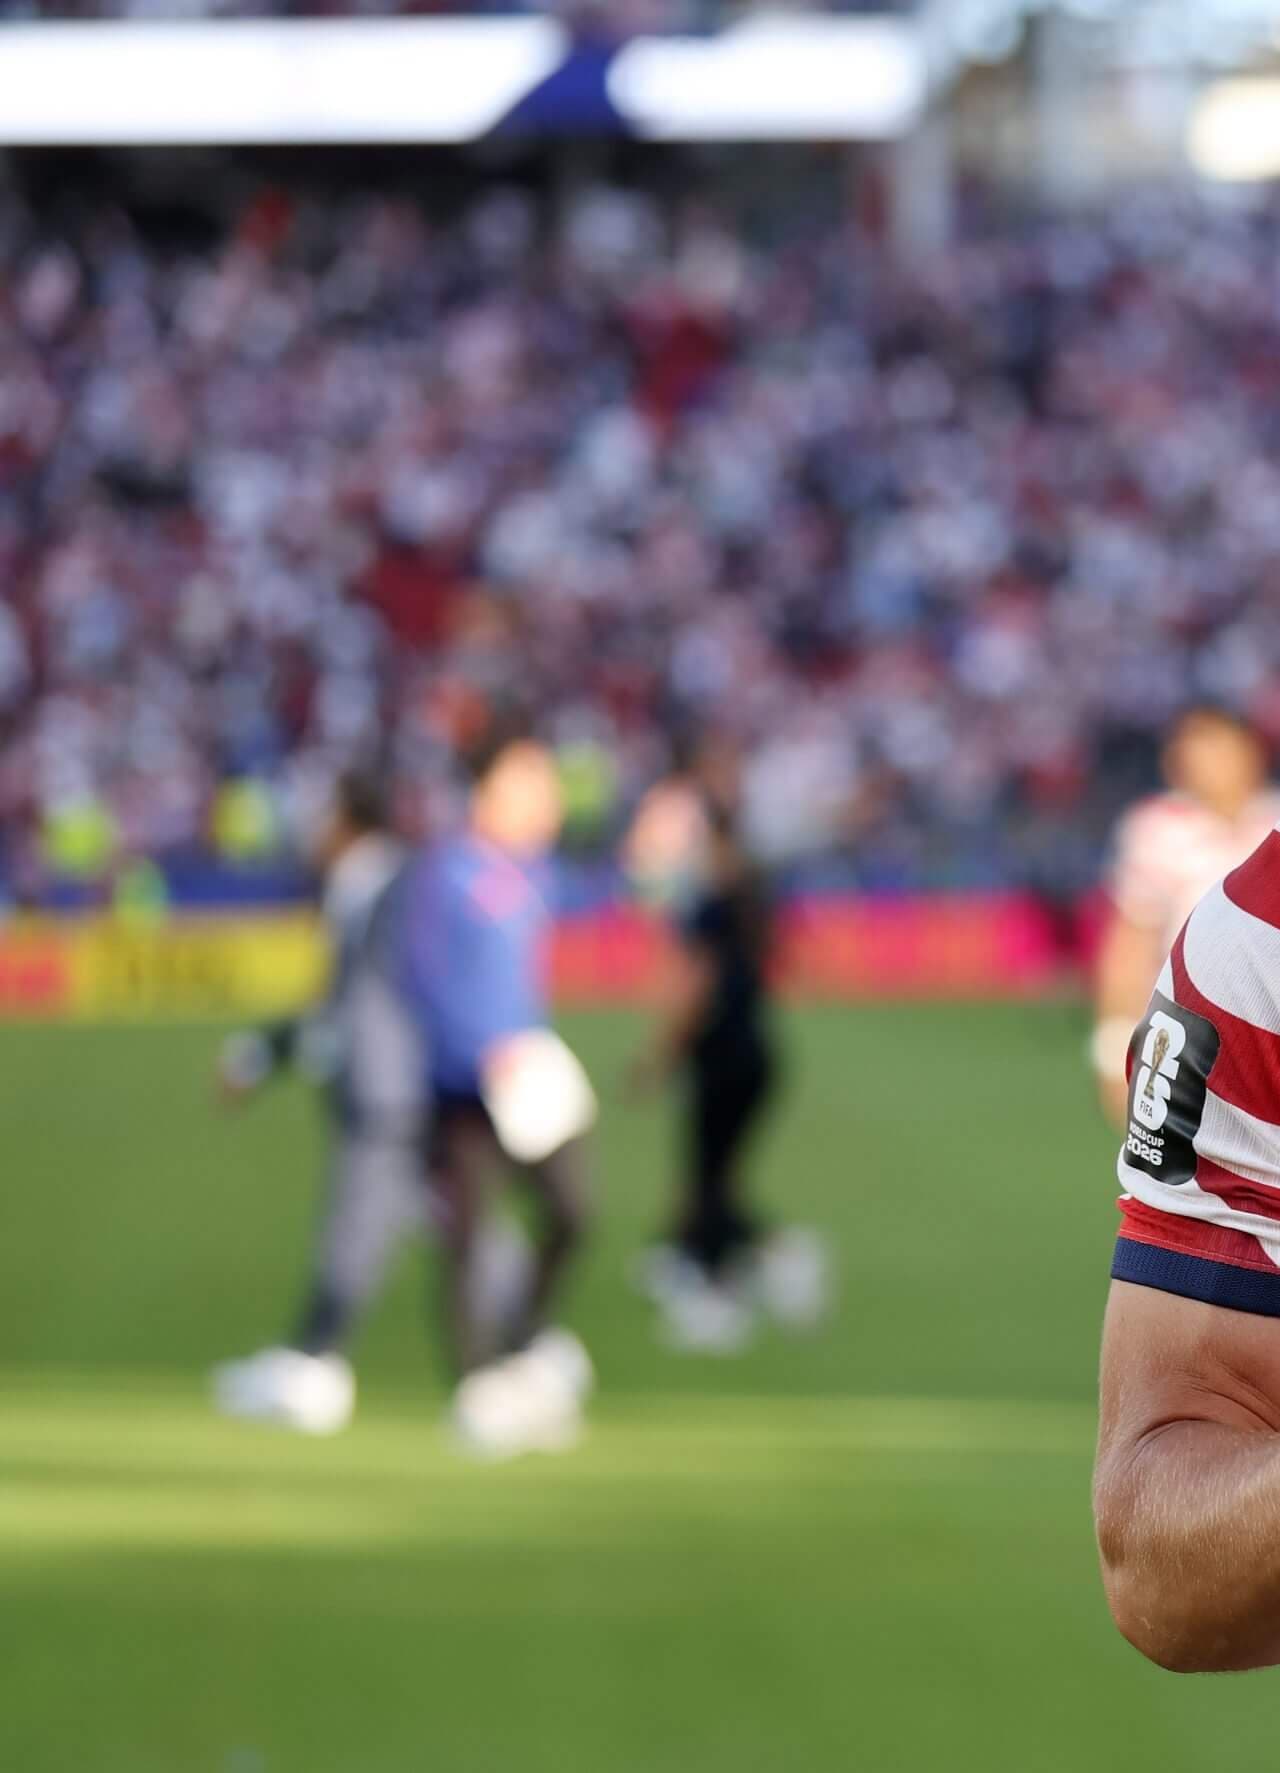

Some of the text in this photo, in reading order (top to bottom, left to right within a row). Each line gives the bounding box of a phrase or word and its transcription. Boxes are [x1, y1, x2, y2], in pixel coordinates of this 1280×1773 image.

[1139, 1100, 1153, 1120] FIFA
[1126, 1132, 1164, 1166] 2026
[1146, 1134, 1165, 1148] CUP
